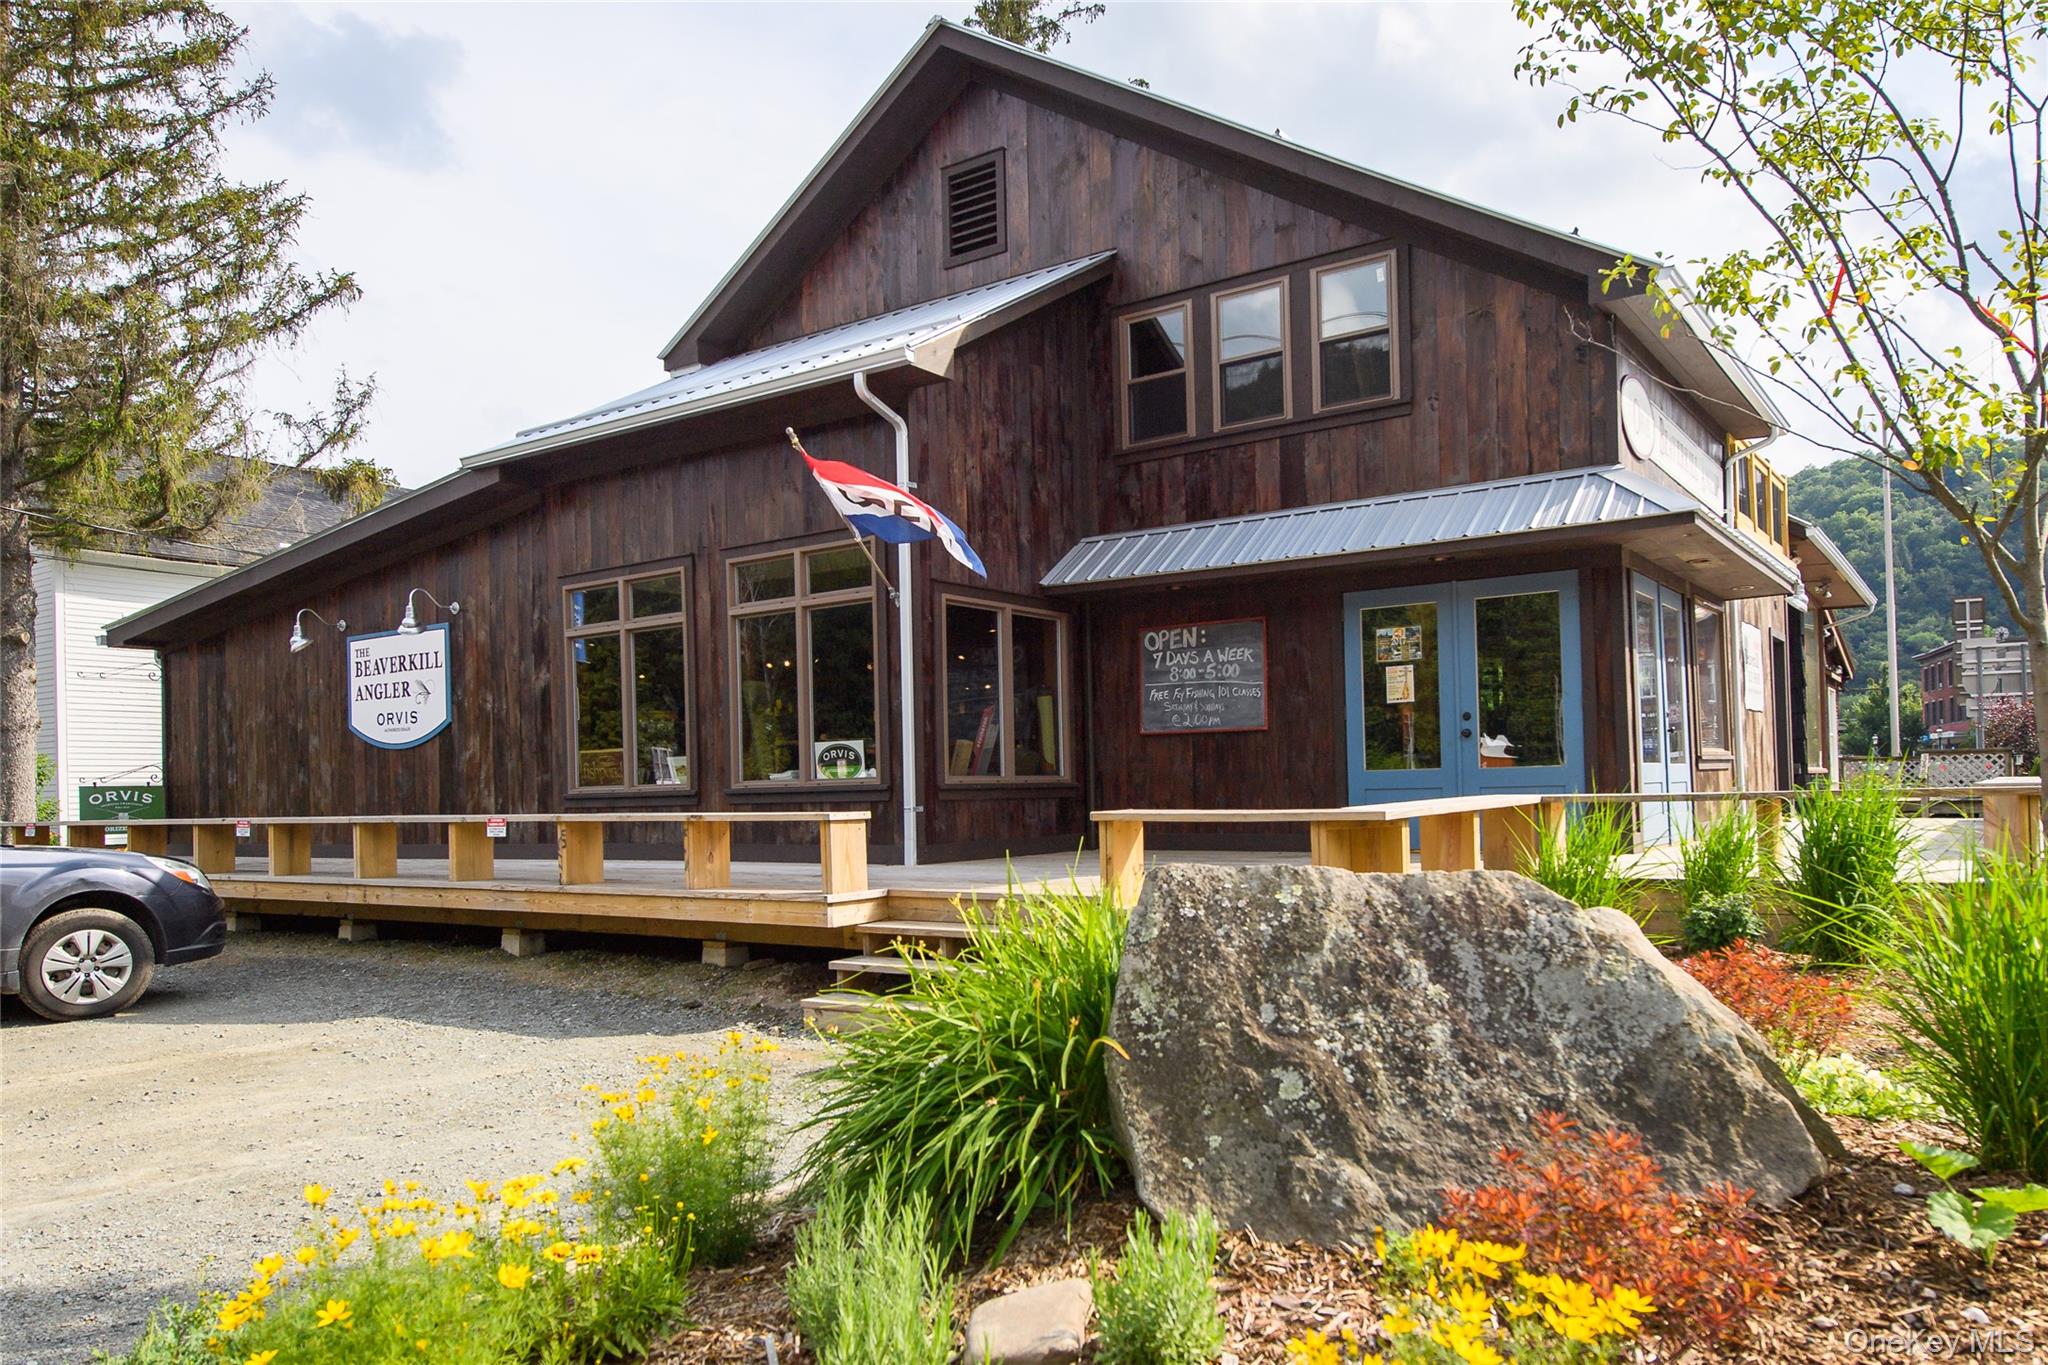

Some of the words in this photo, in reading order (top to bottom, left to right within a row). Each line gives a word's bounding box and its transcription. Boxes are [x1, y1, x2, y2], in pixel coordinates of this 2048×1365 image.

[1144, 627, 1206, 651] OPEN:
[355, 647, 370, 658] THE
[1153, 652, 1163, 668] 7
[1166, 651, 1199, 666] DAYS
[1203, 649, 1214, 663] A
[1217, 647, 1254, 662] WEEK
[355, 651, 443, 678] BEAVERKILL
[355, 681, 411, 702] ANGLER
[1149, 688, 1169, 702] FREE
[1218, 685, 1230, 698] 101
[1232, 687, 1262, 698] CLASSES
[377, 710, 418, 726] ORVIS
[823, 749, 855, 761] ORVIS
[88, 790, 153, 805] ORVIS
